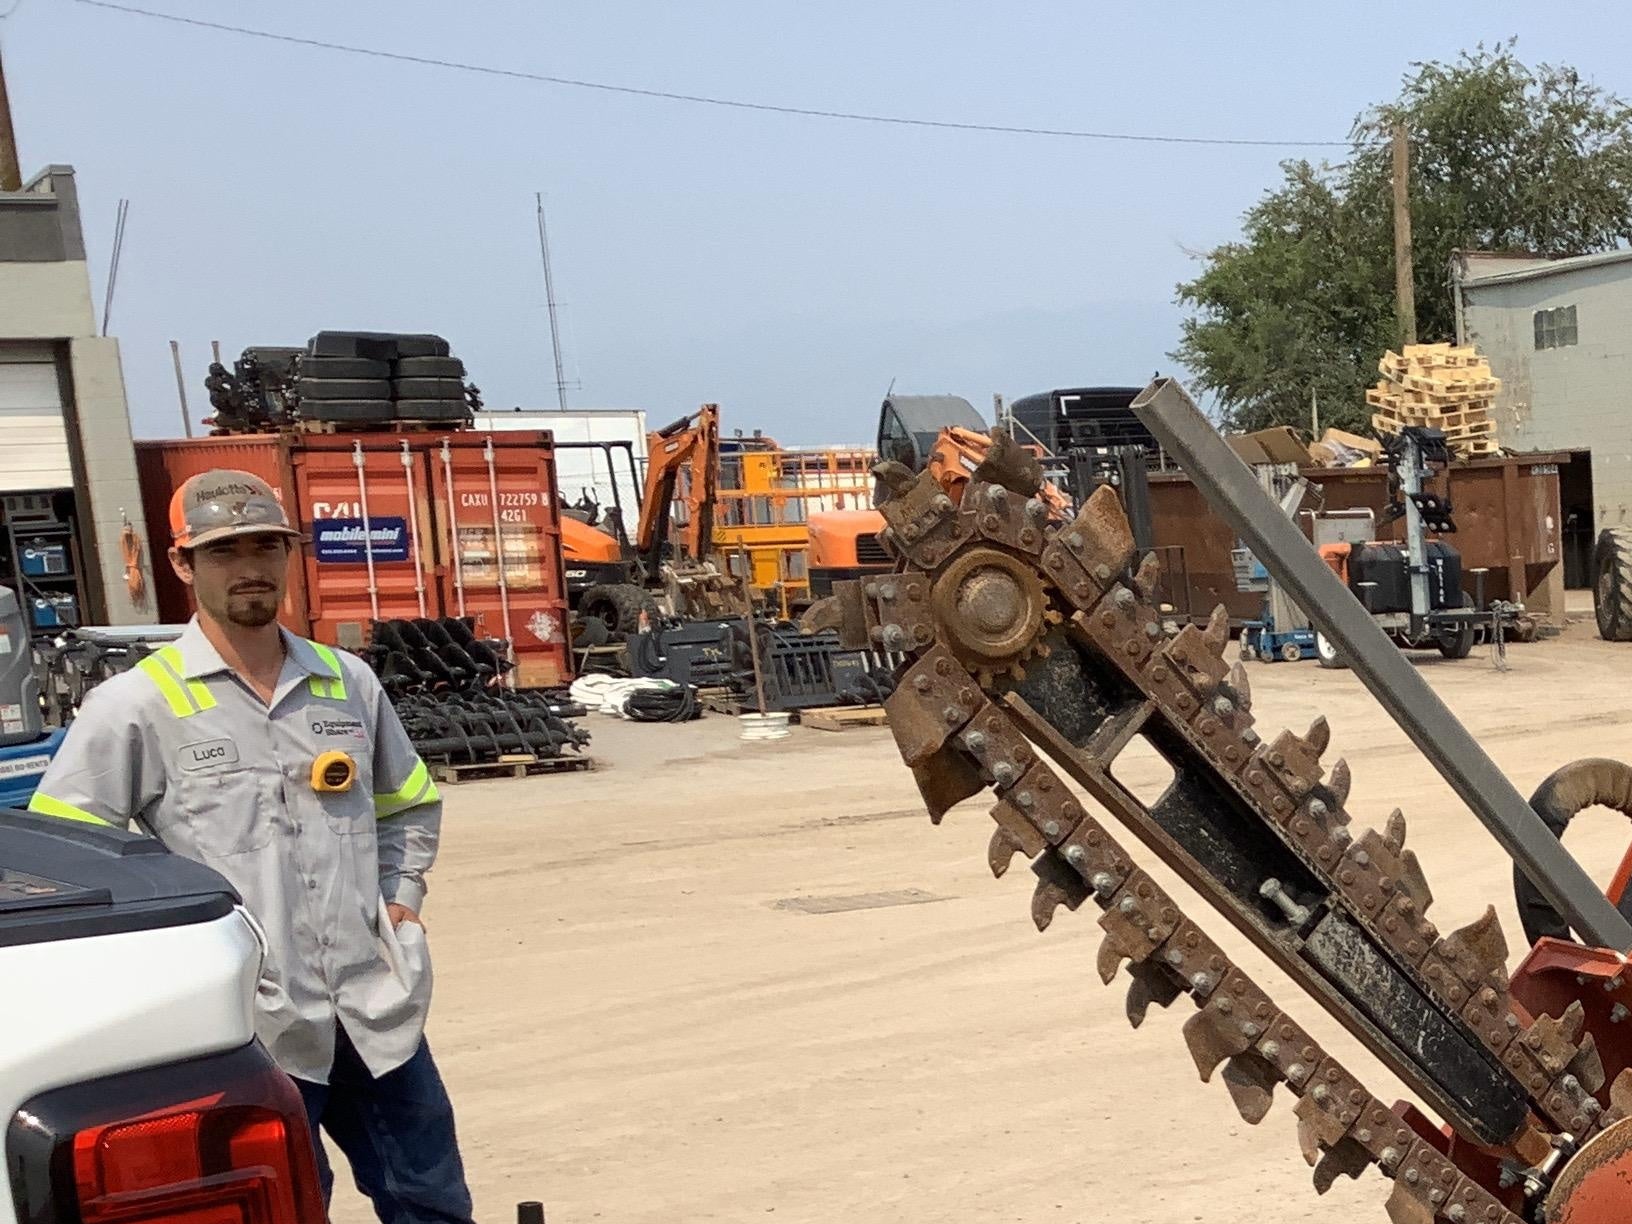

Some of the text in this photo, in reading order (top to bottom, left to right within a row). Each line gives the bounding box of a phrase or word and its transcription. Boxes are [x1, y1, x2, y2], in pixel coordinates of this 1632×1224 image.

[461, 493, 489, 506] CAXU
[499, 492, 537, 506] 722759
[192, 746, 226, 762] Luca
